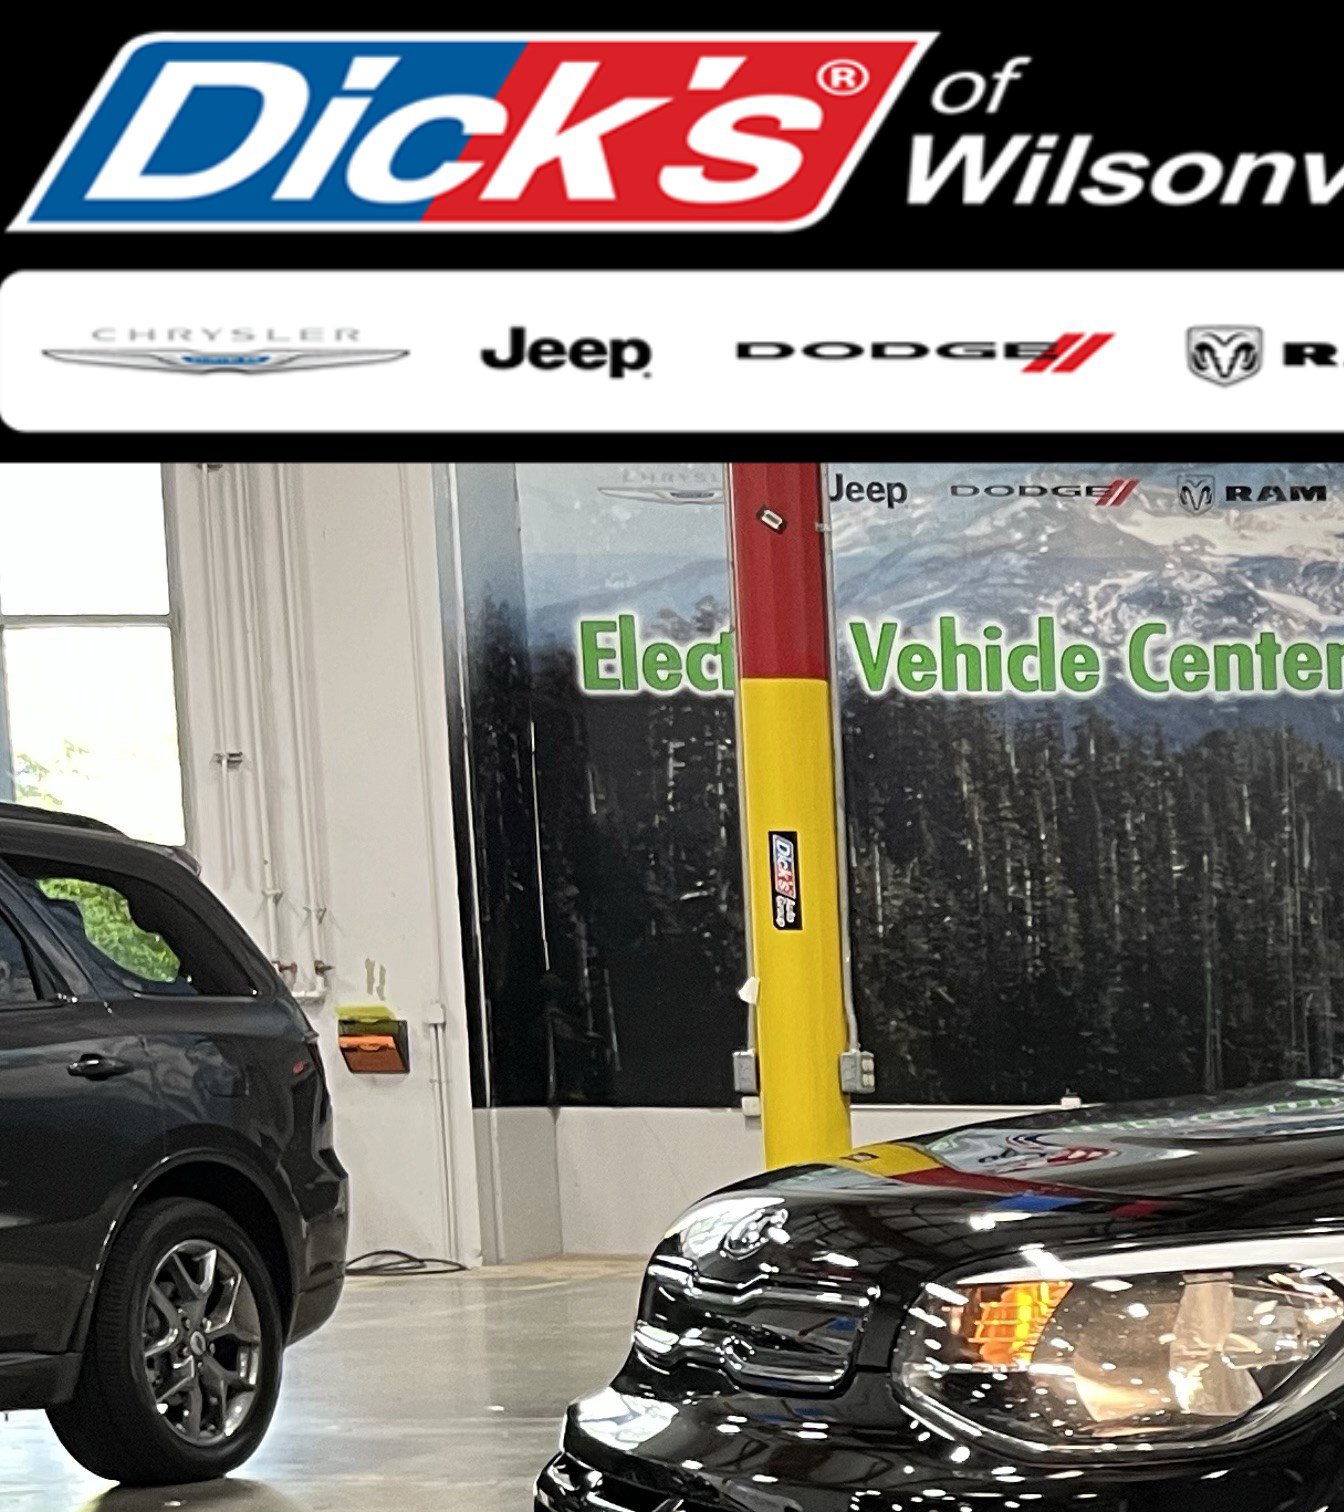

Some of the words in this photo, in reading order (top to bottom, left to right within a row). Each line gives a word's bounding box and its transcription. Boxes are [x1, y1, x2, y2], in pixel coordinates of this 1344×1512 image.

[829, 473, 908, 509] Jeep
[950, 483, 1112, 498] DODGE
[1225, 484, 1328, 502] RAM
[580, 613, 736, 692] Elect
[848, 615, 1101, 694] Vehicle
